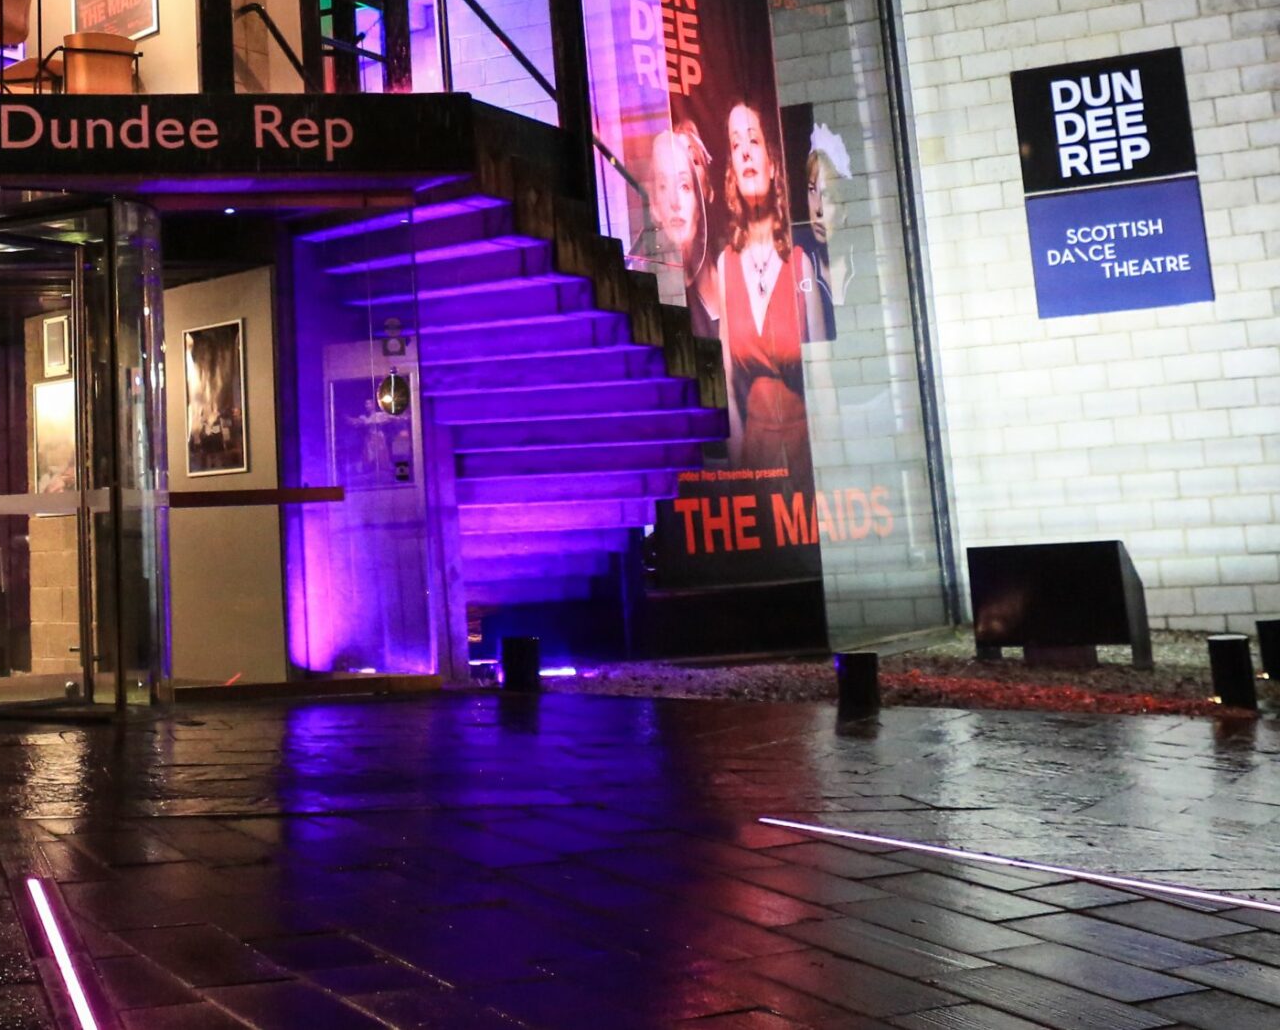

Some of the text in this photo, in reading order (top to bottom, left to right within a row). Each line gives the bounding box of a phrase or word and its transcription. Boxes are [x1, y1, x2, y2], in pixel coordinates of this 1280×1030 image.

[81, 0, 106, 29] THE
[632, 44, 702, 96] REP
[1051, 69, 1143, 112] DUN
[0, 103, 218, 149] Dundee
[254, 104, 354, 160] Rep
[1055, 102, 1147, 144] DEE
[1059, 136, 1151, 178] REP
[1066, 218, 1163, 245] SCOTTISH
[1101, 254, 1191, 279] THEATRE
[674, 486, 894, 554] THE MAIDS
